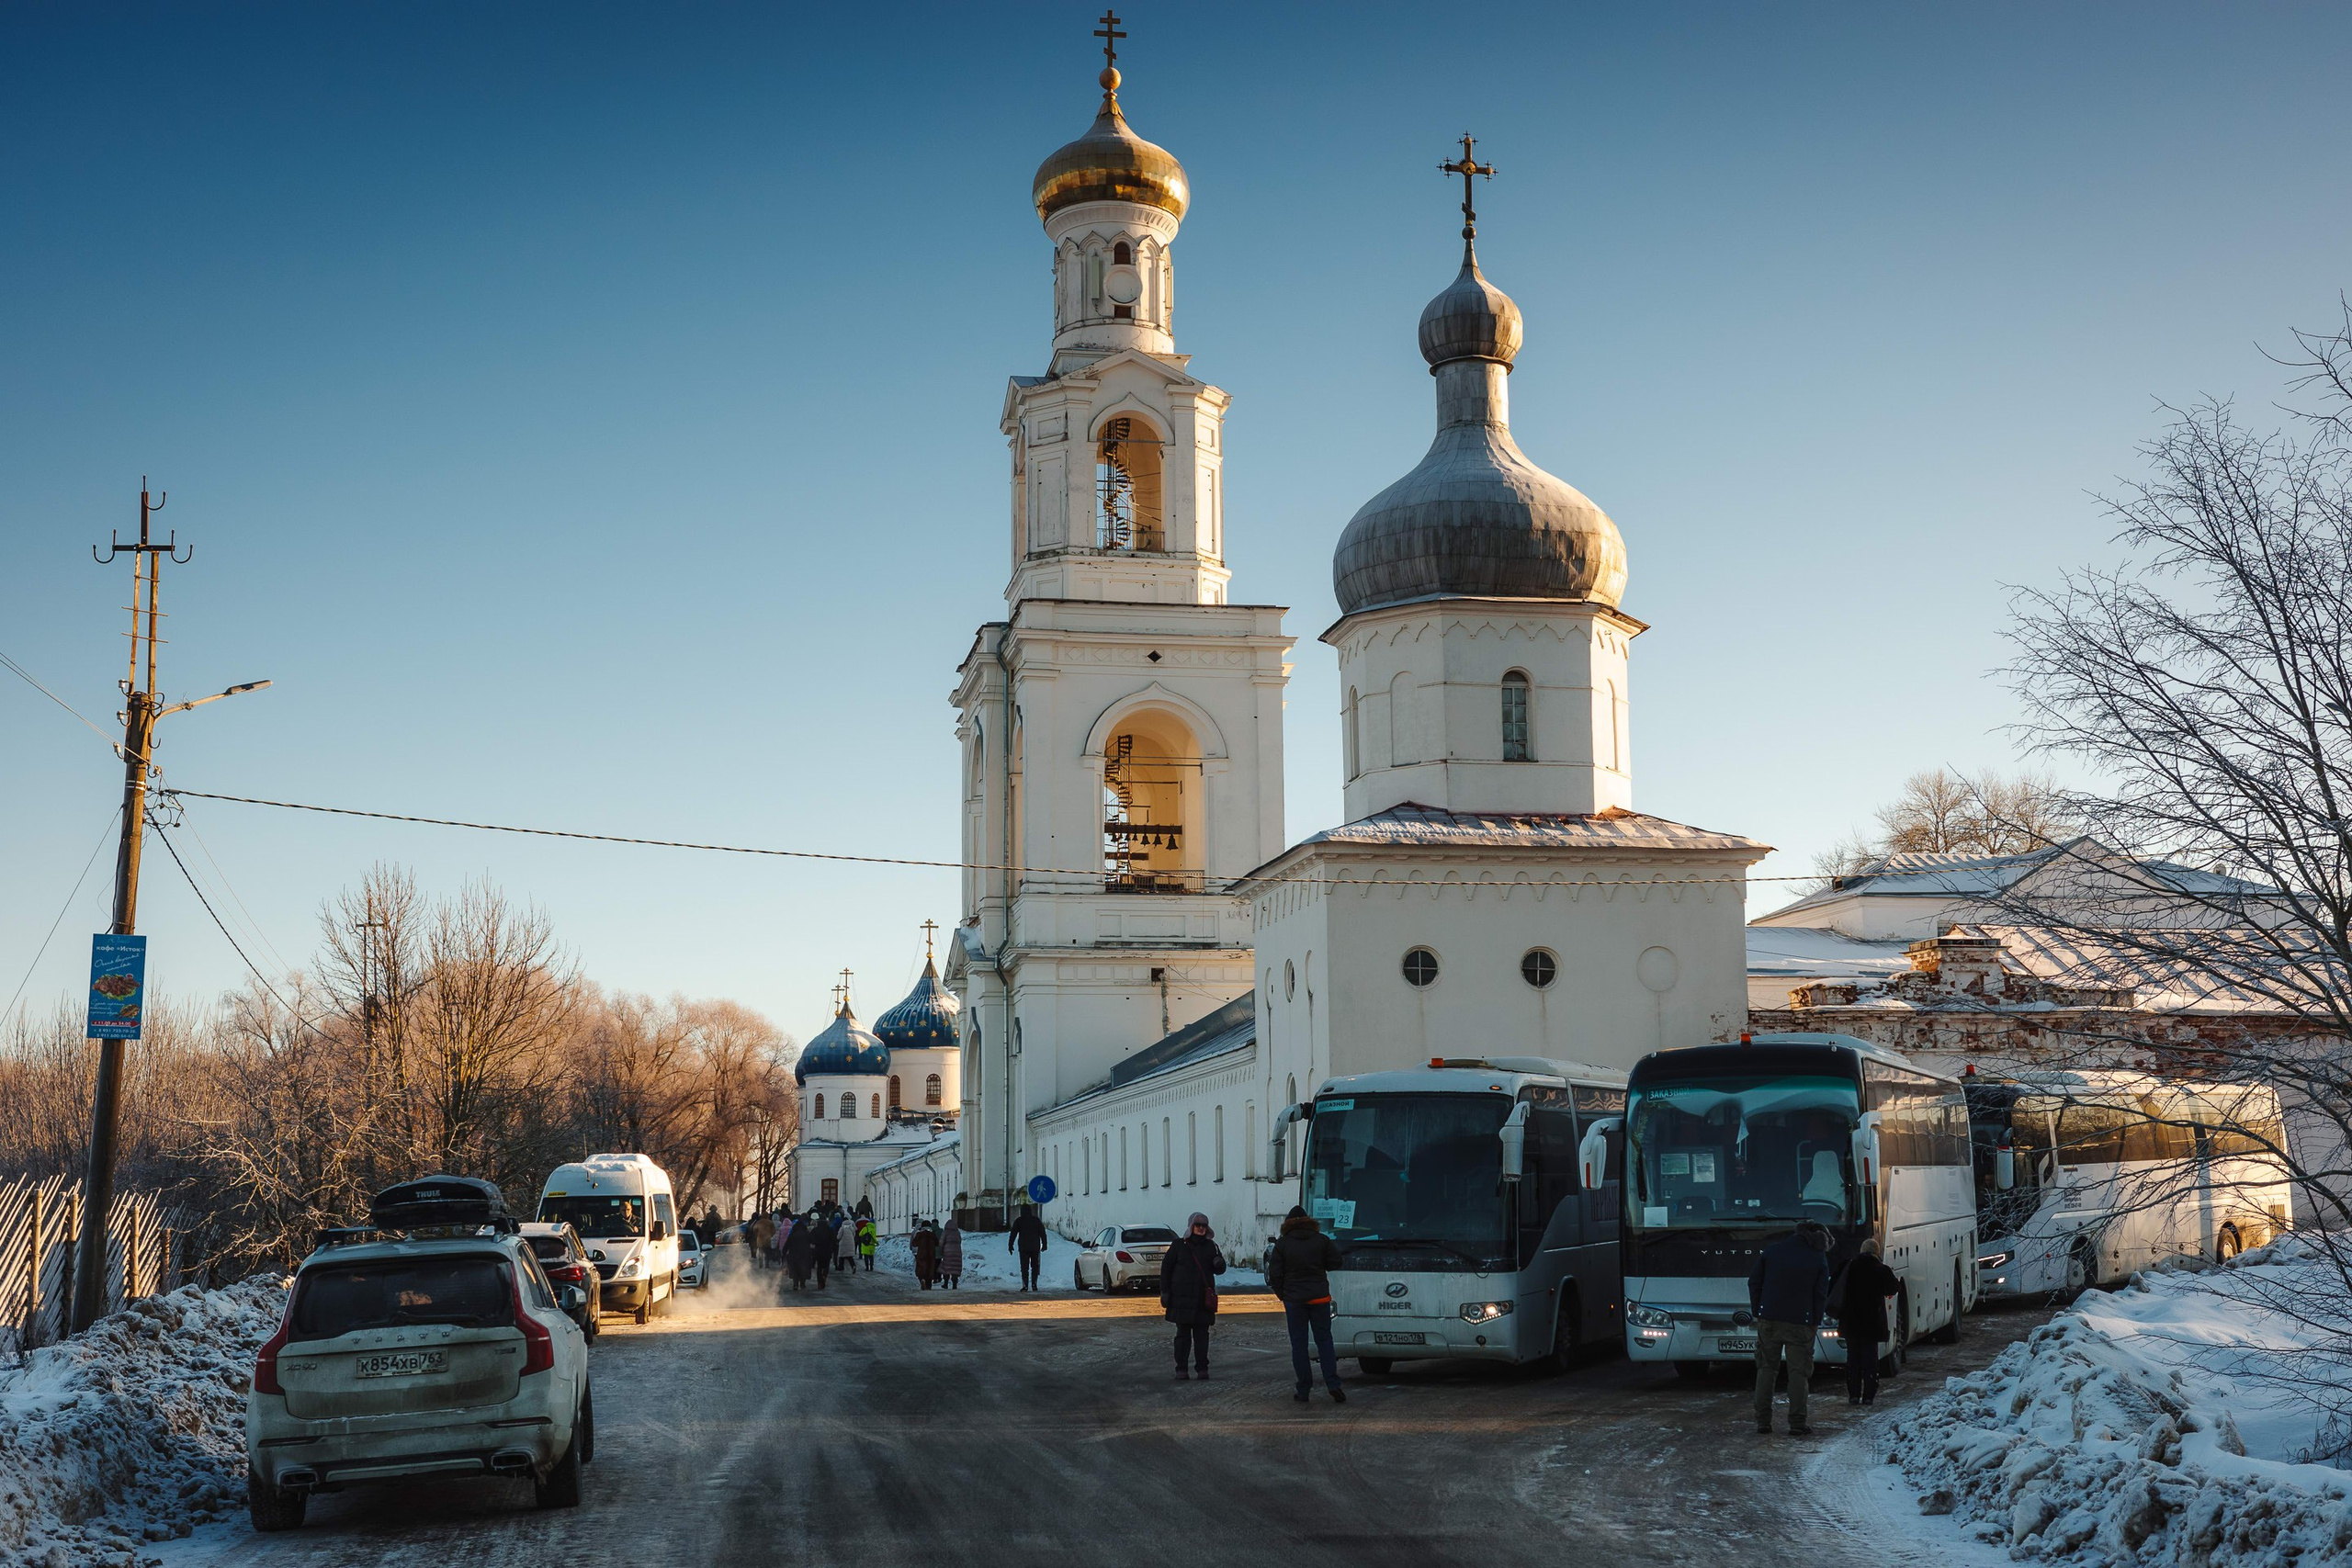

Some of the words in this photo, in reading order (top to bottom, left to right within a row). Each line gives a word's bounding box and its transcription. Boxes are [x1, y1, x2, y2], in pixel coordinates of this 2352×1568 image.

[415, 1190, 441, 1198] THULE
[1338, 1214, 1350, 1224] 23
[1378, 1301, 1412, 1310] HIGER
